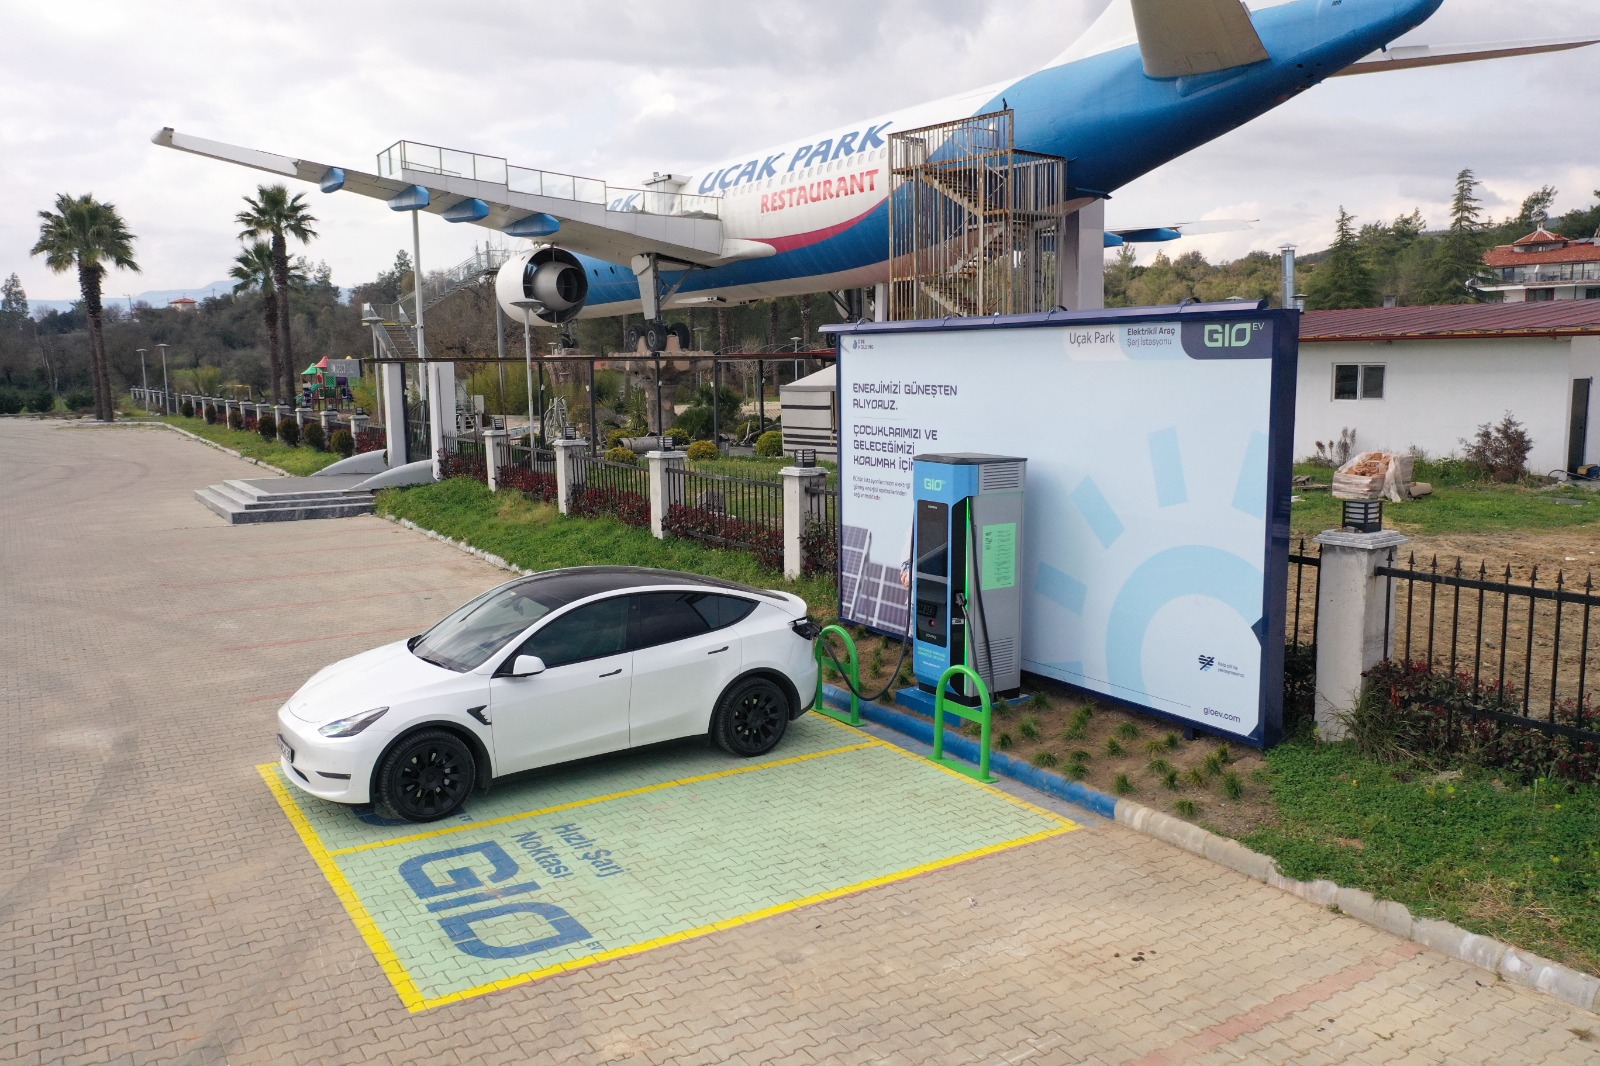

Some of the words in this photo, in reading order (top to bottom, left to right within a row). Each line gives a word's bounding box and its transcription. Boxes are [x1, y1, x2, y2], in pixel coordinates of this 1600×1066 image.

[787, 121, 893, 173] PARK
[760, 169, 879, 214] RESTAURANT
[1069, 331, 1092, 347] Uçak
[1094, 331, 1115, 344] Park
[1158, 327, 1175, 337] Araç
[1203, 323, 1251, 347] GIO
[1252, 322, 1265, 331] EV
[852, 380, 901, 395] ENERJİMİZİ
[904, 381, 958, 398] GÜNEŞTEN
[852, 398, 898, 410] ALIYORUZ.
[853, 424, 921, 440] ÇOCUKLARIMIZI
[924, 429, 938, 441] VE
[853, 439, 915, 456] GELECEĞİMİZİ
[853, 454, 896, 470] KORUMAK
[923, 477, 942, 492] GIO
[511, 831, 575, 879] Noktası
[551, 822, 596, 850] Hızlı
[576, 848, 631, 878] Şarj
[398, 840, 593, 959] GIO
